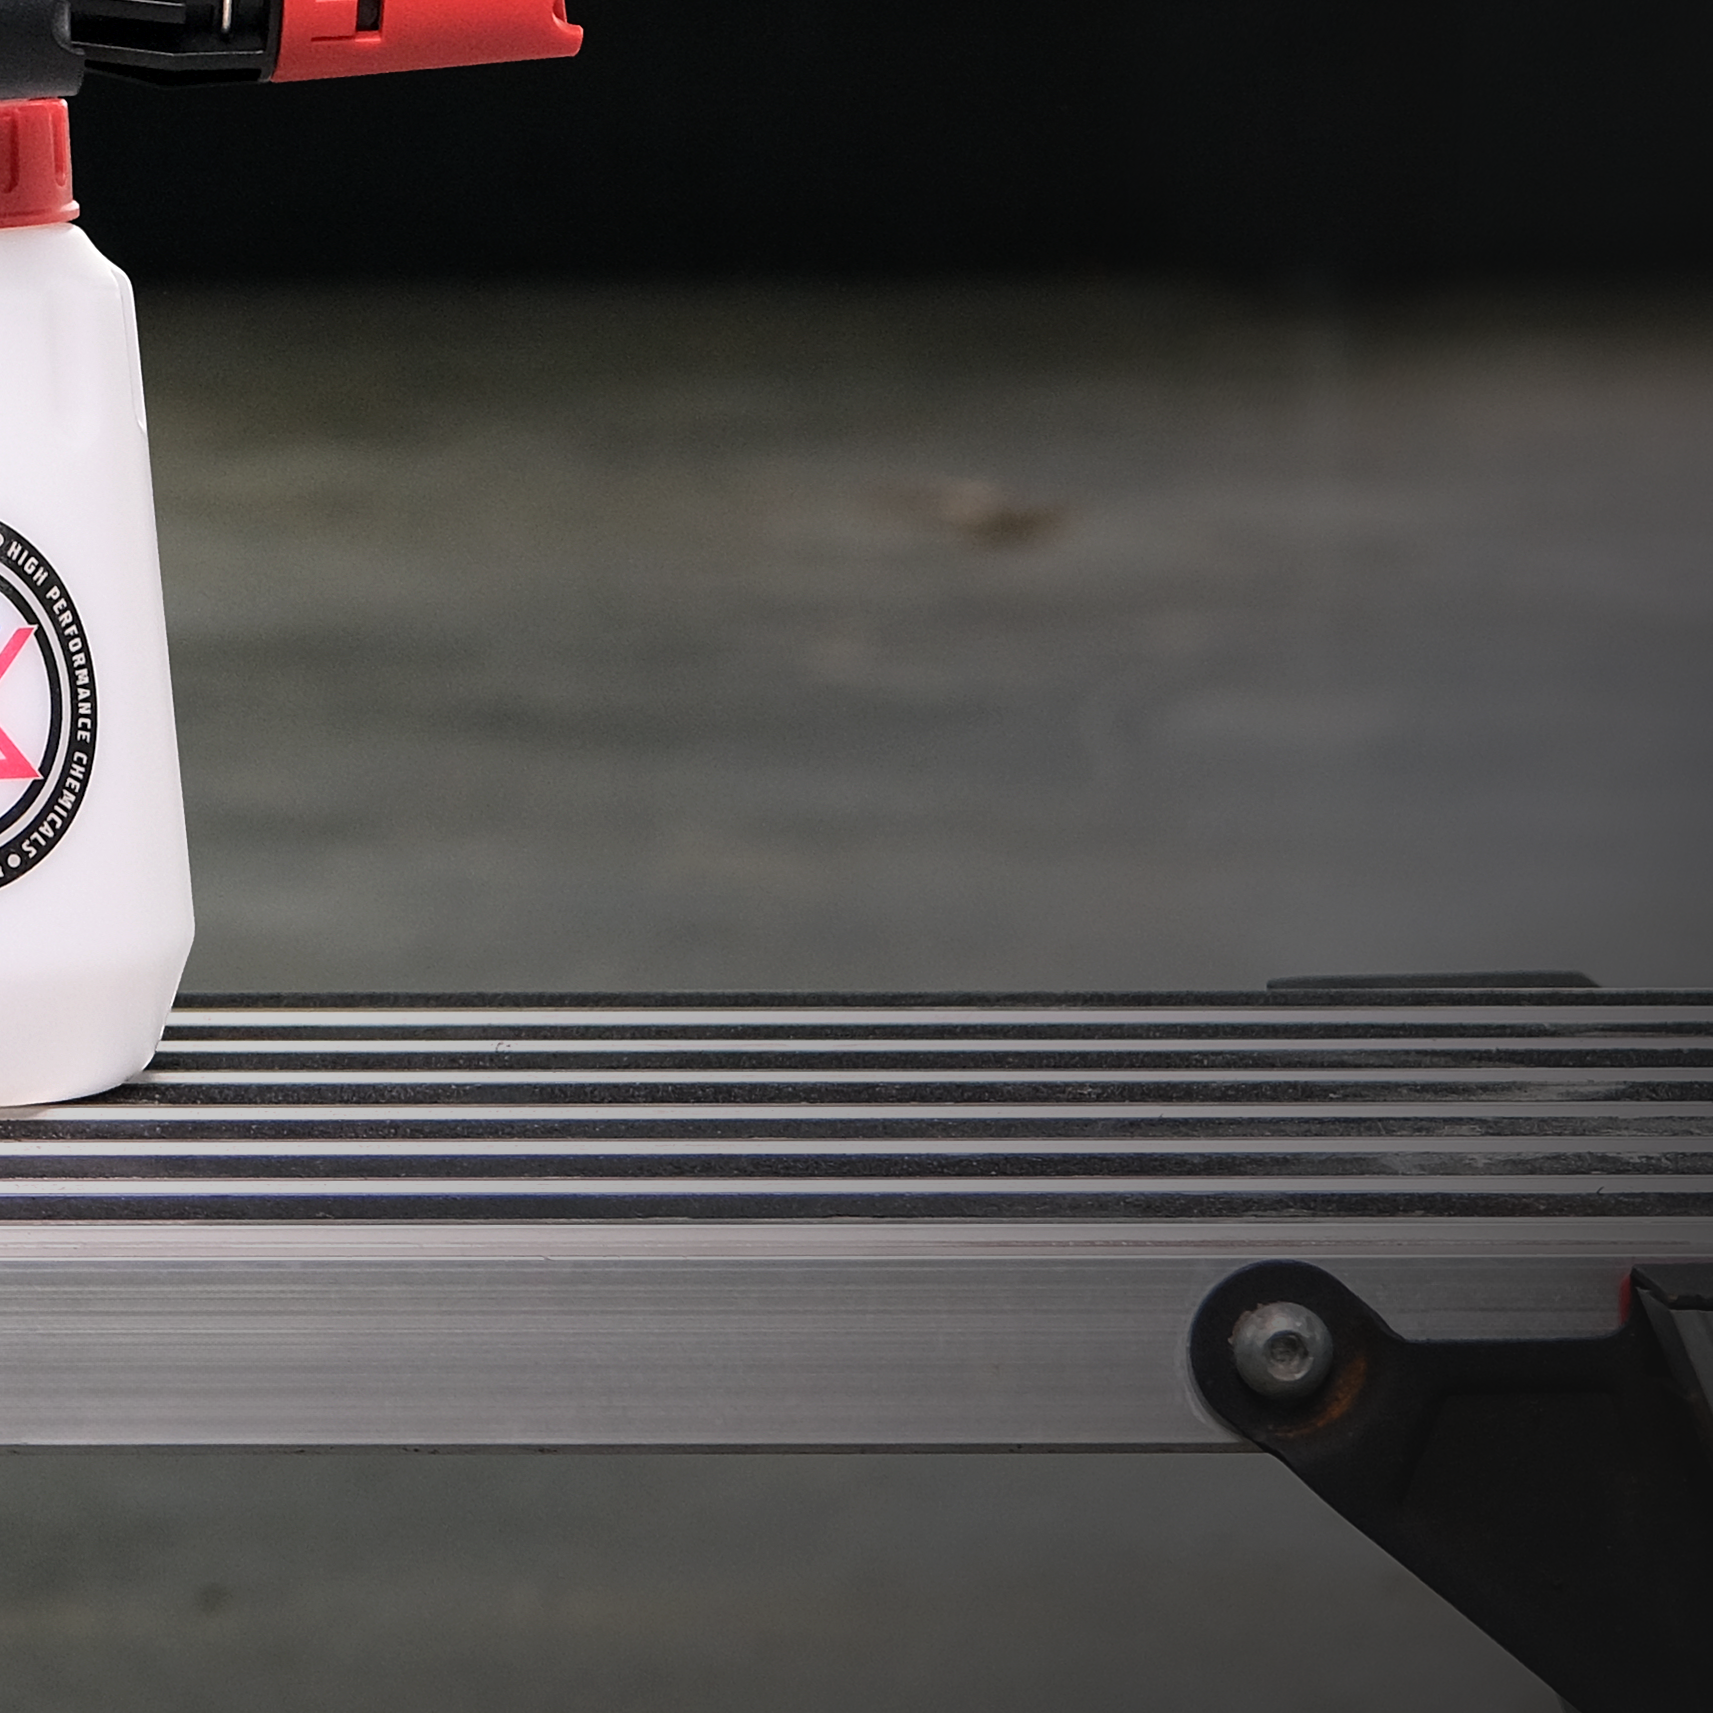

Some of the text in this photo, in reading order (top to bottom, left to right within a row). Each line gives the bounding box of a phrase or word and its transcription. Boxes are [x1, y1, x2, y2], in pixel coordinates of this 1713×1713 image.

[7, 540, 93, 860] HIGH PERFORMANCE CHEMICALS
